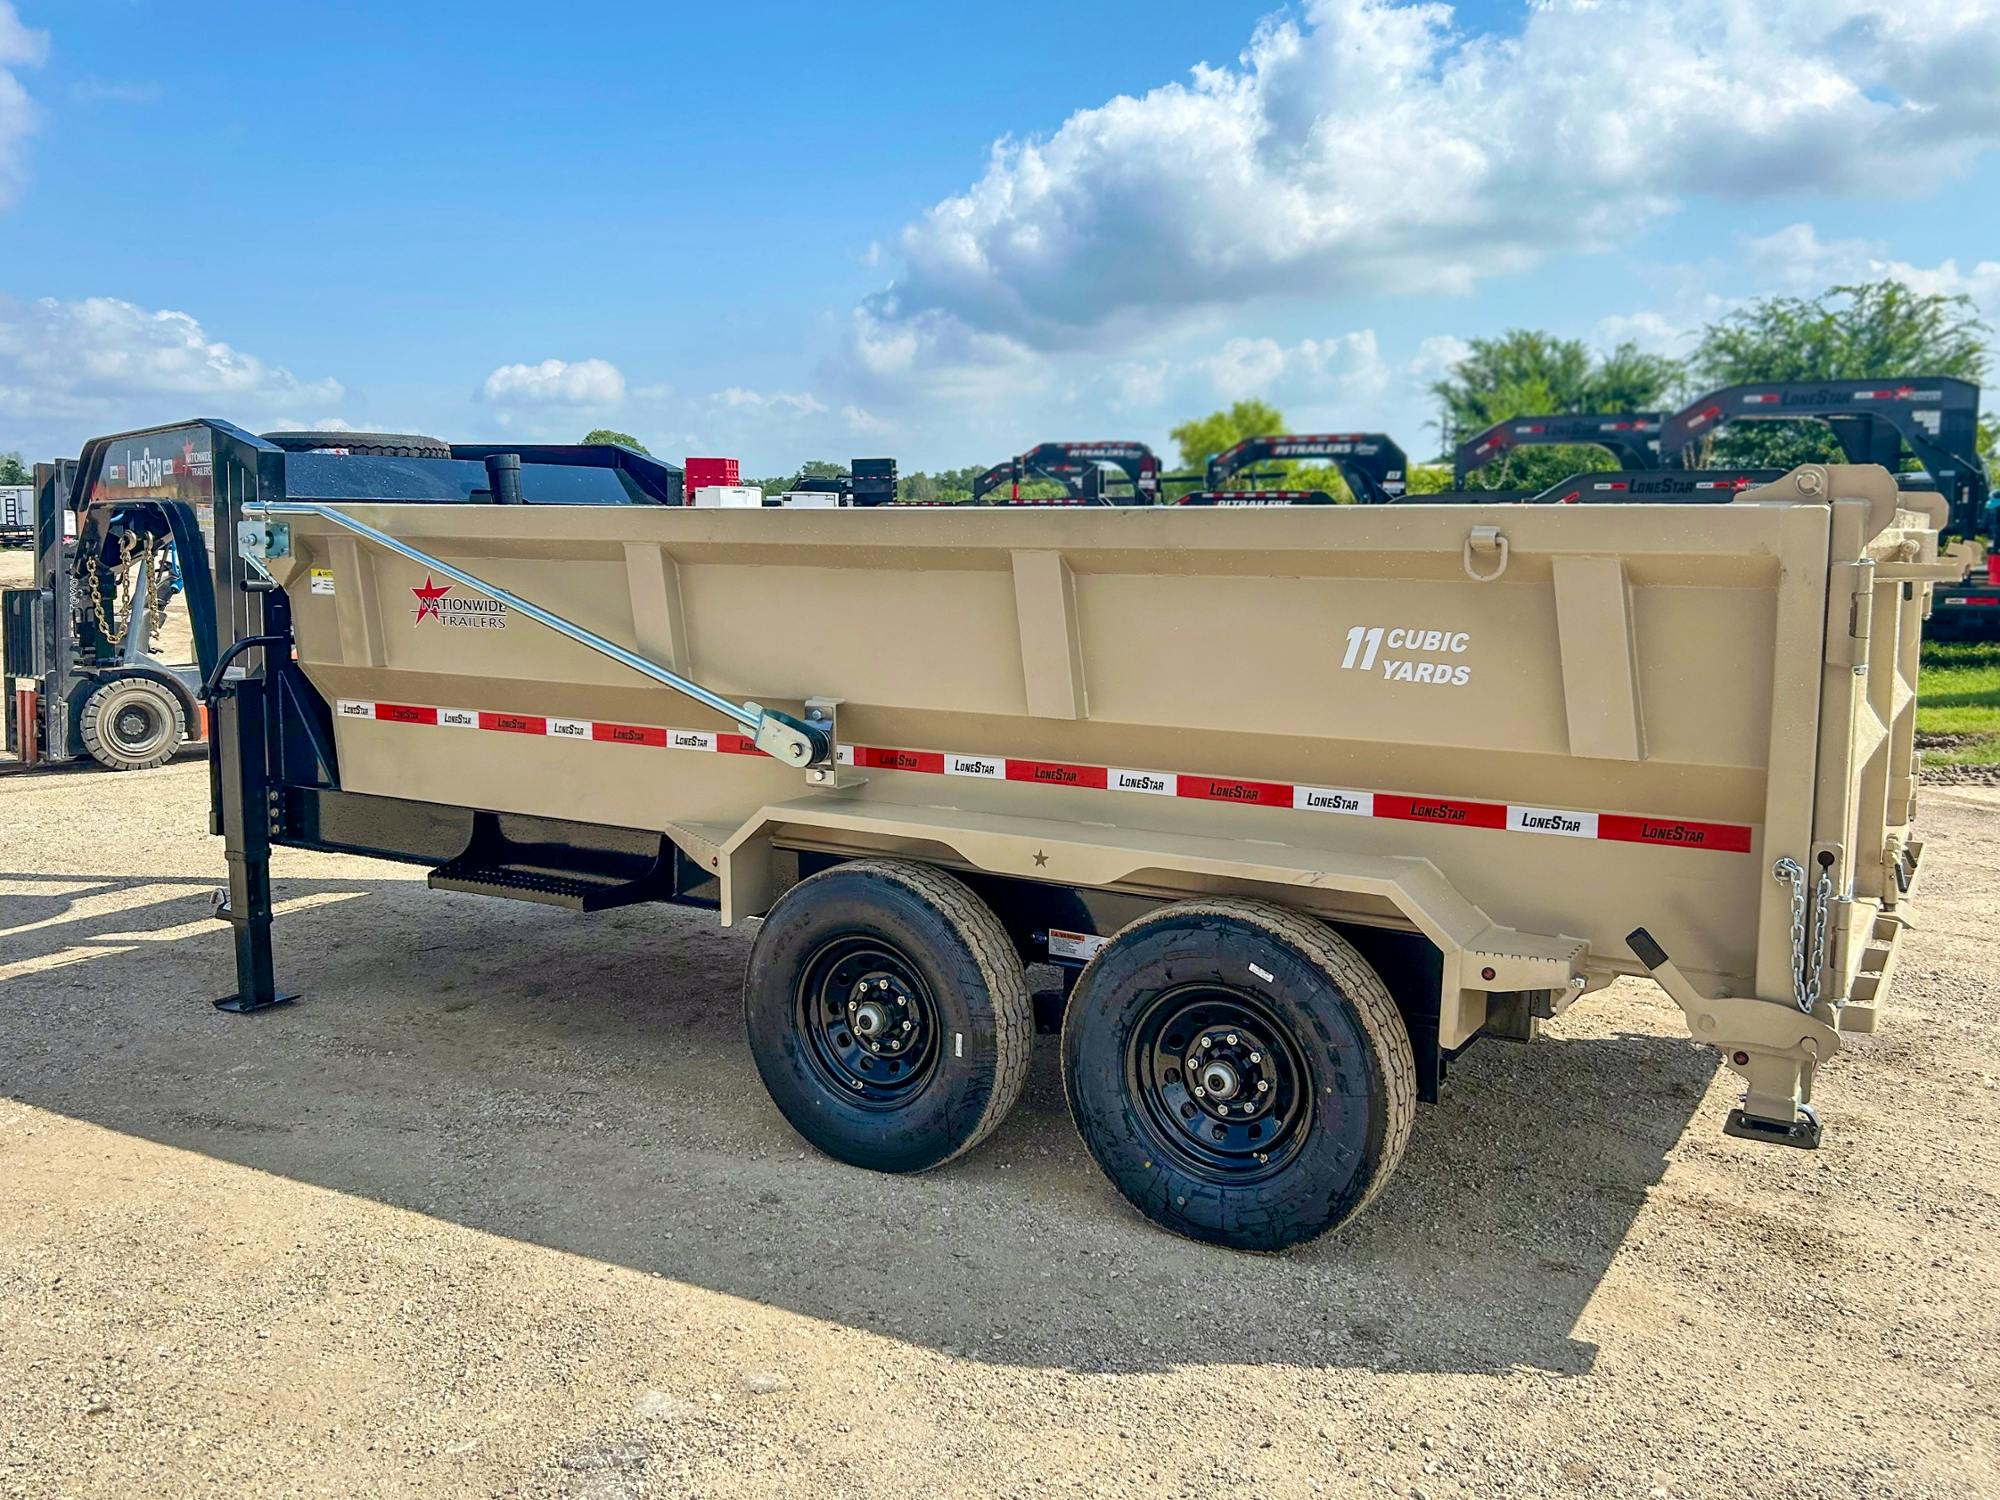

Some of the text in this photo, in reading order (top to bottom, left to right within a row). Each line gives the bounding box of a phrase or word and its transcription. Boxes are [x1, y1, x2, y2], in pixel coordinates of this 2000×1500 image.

[127, 447, 162, 488] LONESTAR
[191, 466, 212, 477] TRAILERS
[1629, 478, 1695, 494] LONESTAR
[422, 598, 506, 612] NATIONWIDE
[441, 616, 506, 628] TRAILERS
[1340, 626, 1470, 671] 11 CUBIC
[1383, 660, 1471, 686] YARDS
[444, 713, 472, 725] LONESTAR
[554, 723, 584, 735] LONESTAR
[613, 729, 645, 742] LONESTAR
[675, 734, 708, 748] LONESTAR
[880, 754, 918, 767] LONESTAR
[955, 759, 995, 774] LONESTAR
[1034, 766, 1077, 782] LONESTAR
[1119, 774, 1164, 791] LONESTAR
[1209, 782, 1259, 800] LONESTAR
[1307, 792, 1359, 811] LONESTAR
[1410, 801, 1466, 820] LONESTAR
[1521, 812, 1580, 832] LONESTAR
[1641, 823, 1705, 843] LONESTAR
